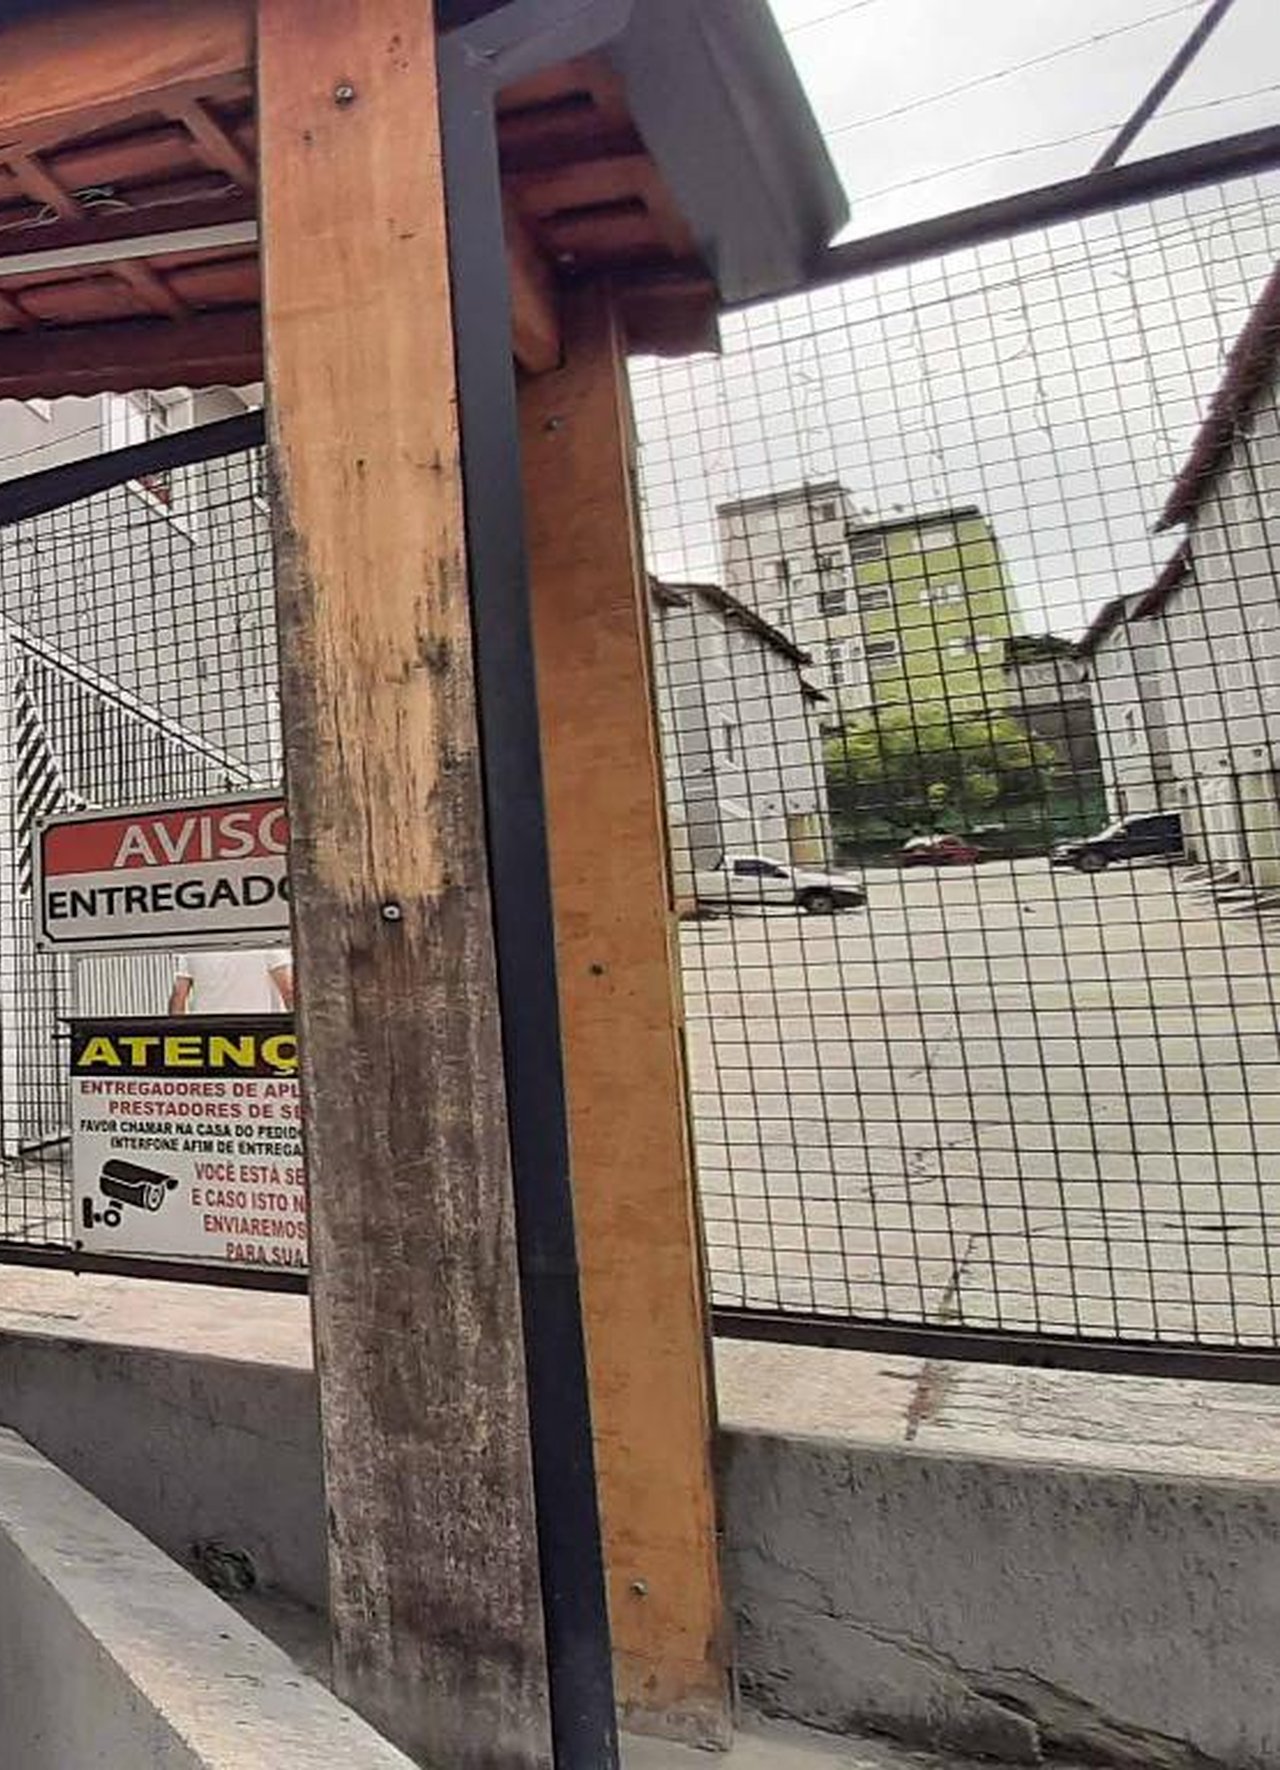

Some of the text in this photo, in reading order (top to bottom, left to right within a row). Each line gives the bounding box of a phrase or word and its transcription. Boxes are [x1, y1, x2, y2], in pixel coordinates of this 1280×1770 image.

[80, 1080, 226, 1098] ENTREGADORES
[233, 1083, 258, 1098] DE
[109, 1100, 243, 1119] PRESTADORES
[249, 1104, 274, 1119] DE
[80, 1119, 118, 1133] FAVOR
[120, 1121, 172, 1135] CHAMAR
[175, 1123, 194, 1135] NA
[196, 1124, 232, 1137] CASA
[235, 1125, 254, 1137] DO
[110, 1136, 179, 1150] INTERFONE
[183, 1139, 214, 1153] AFIM
[217, 1141, 234, 1154] DE
[195, 1160, 235, 1182] VOCÊ
[192, 1188, 202, 1206] E
[205, 1189, 246, 1209] CASO
[252, 1192, 288, 1212] ISTO
[204, 1214, 307, 1241] ENVIAREMOS
[226, 1242, 266, 1266] PARA
